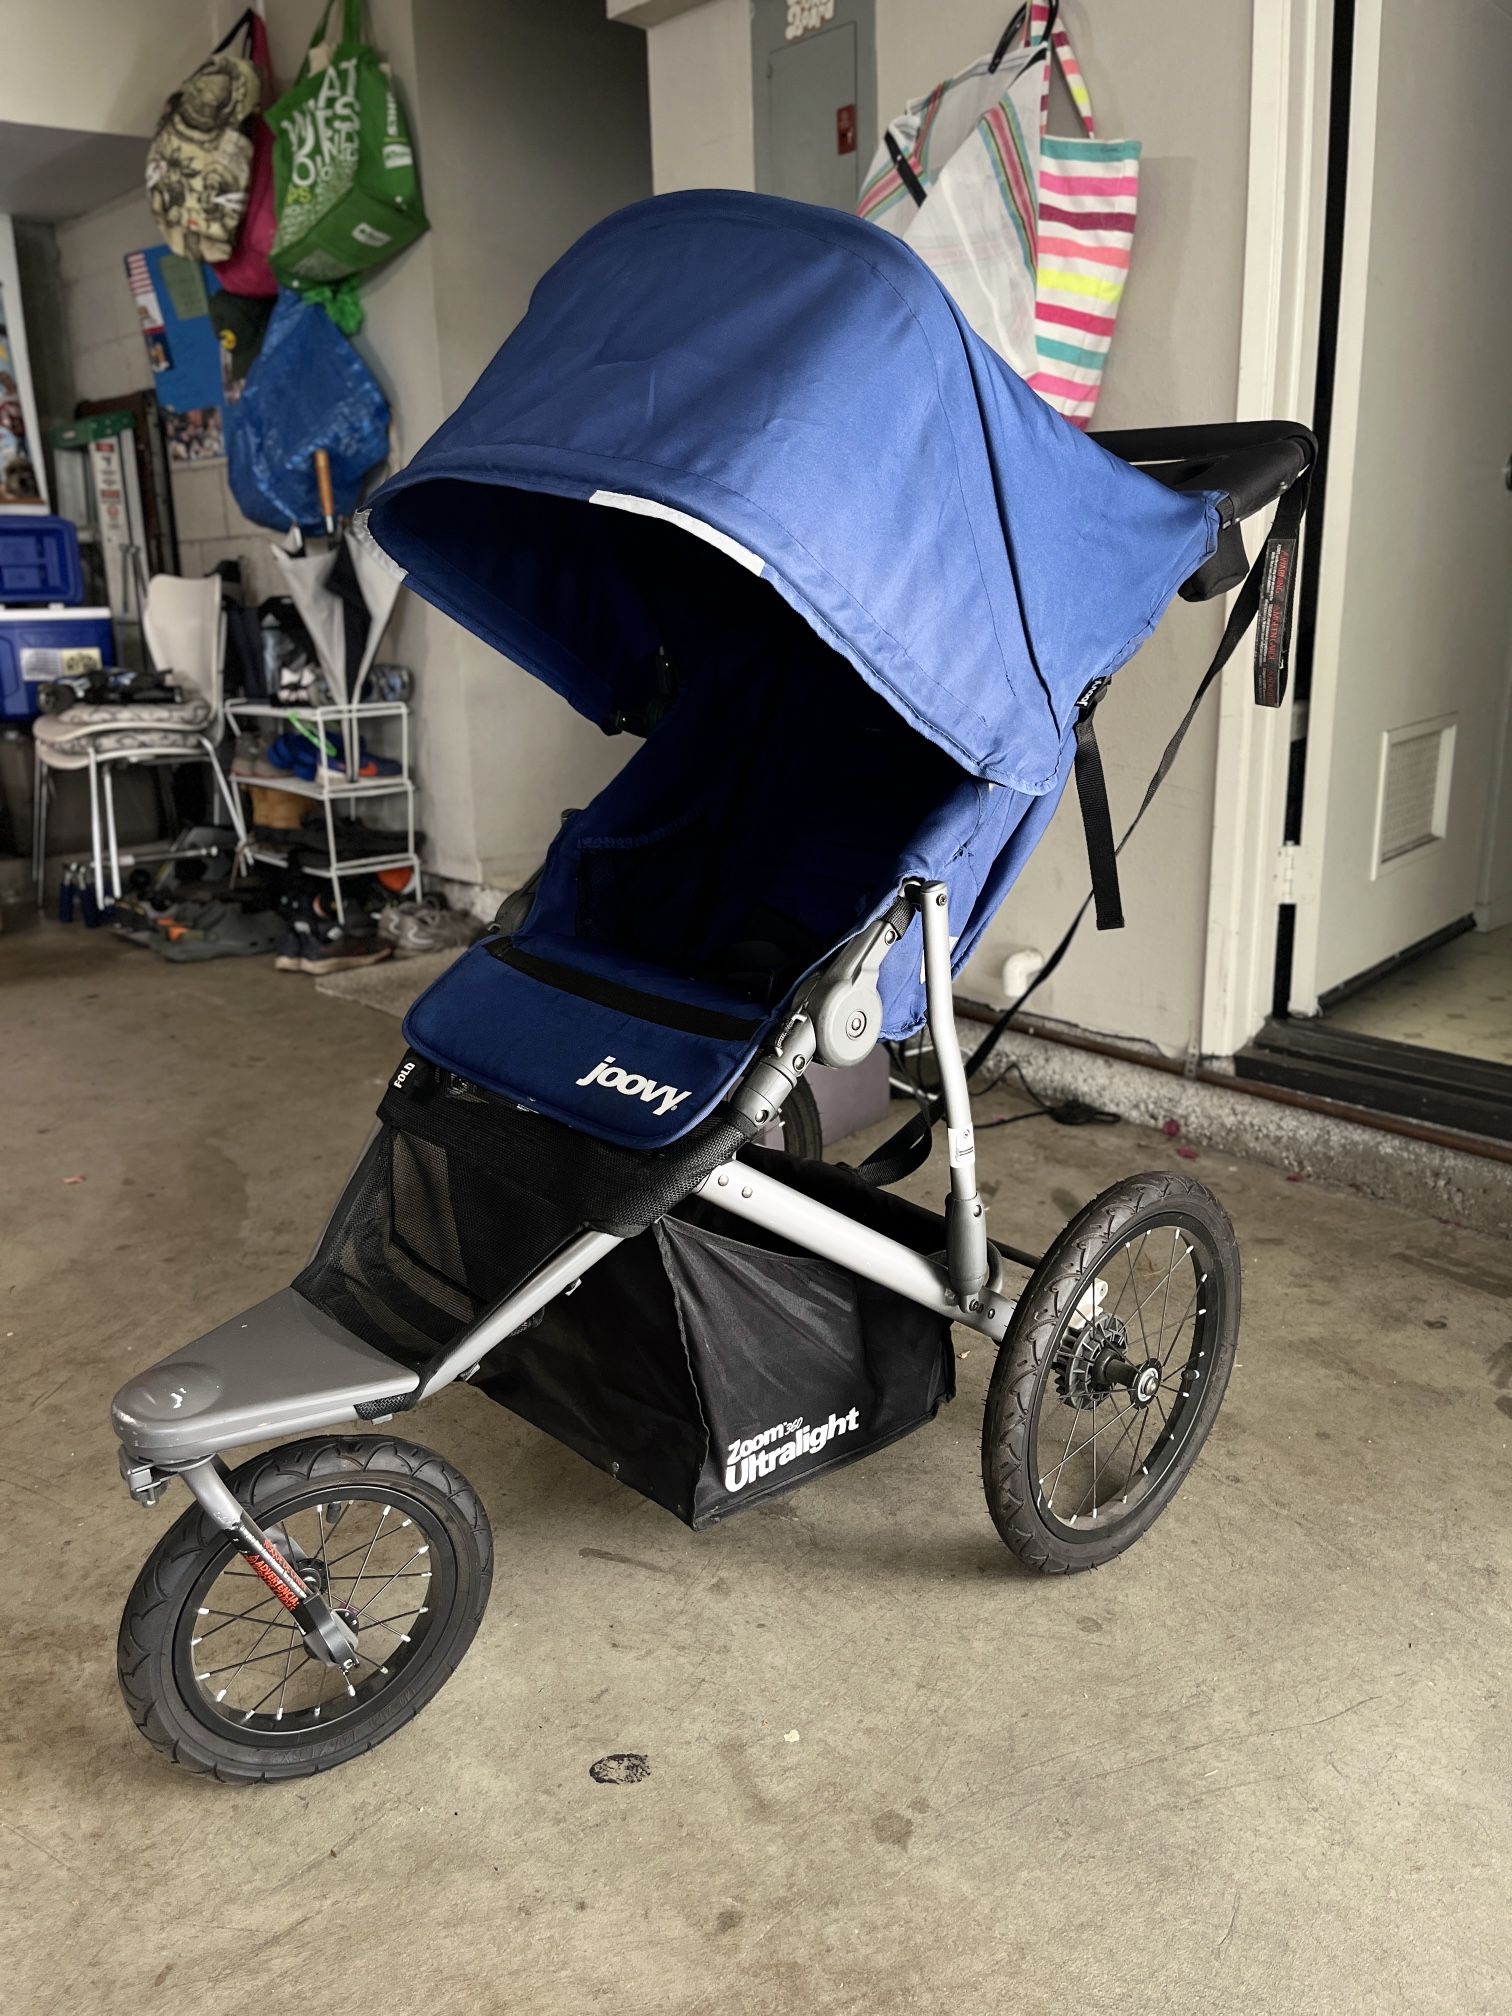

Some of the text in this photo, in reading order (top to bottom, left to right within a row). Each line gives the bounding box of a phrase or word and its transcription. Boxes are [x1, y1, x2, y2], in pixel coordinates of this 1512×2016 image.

[393, 1062, 416, 1089] FOLD
[576, 1056, 692, 1116] joovy
[725, 1406, 860, 1493] Ultralight
[255, 1560, 300, 1608] ADVERTENCIA:
